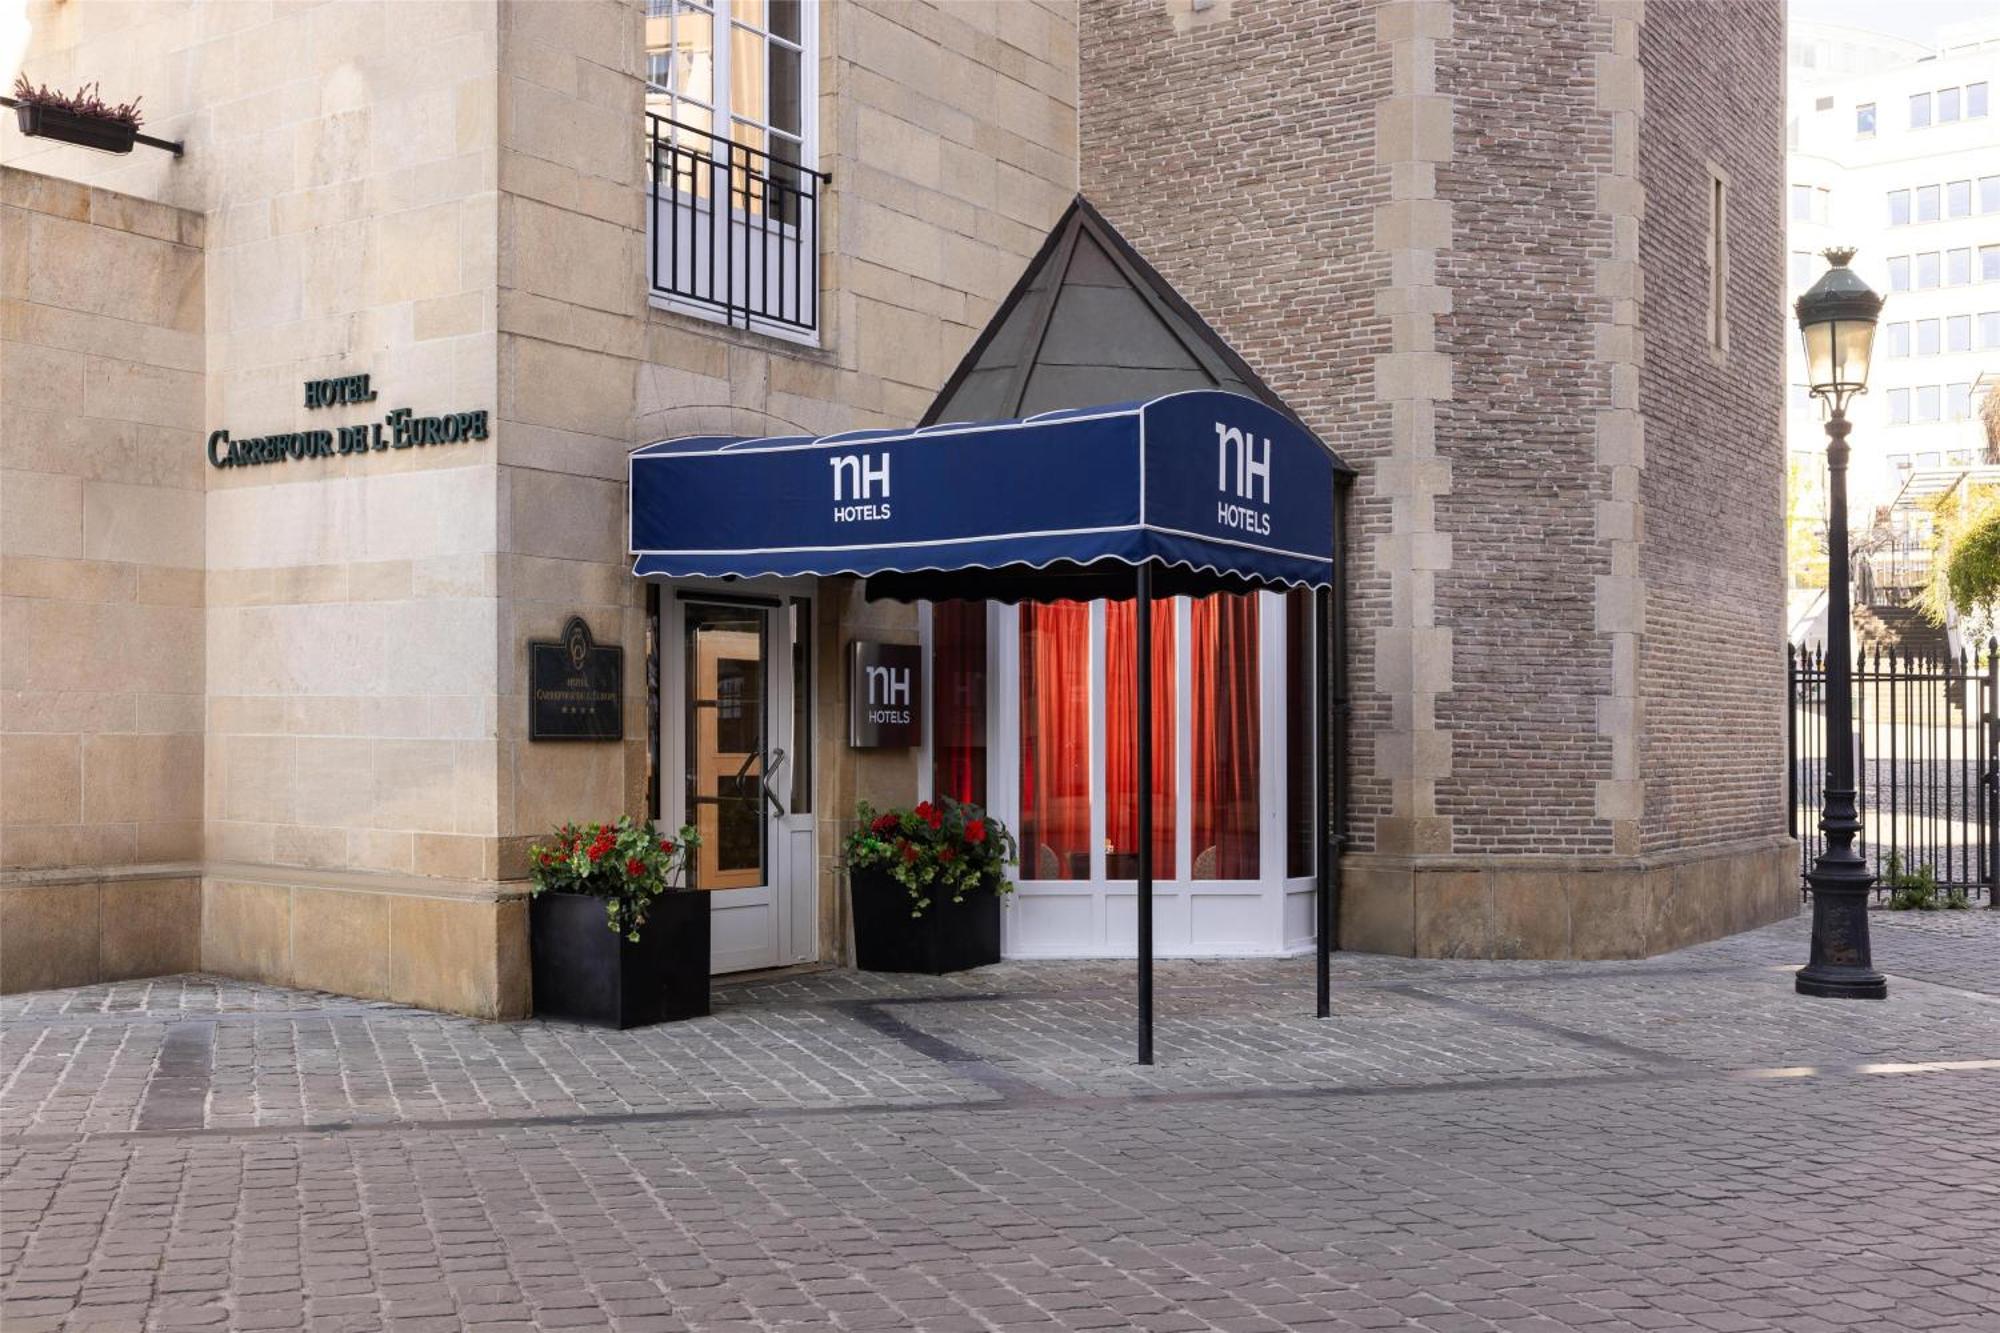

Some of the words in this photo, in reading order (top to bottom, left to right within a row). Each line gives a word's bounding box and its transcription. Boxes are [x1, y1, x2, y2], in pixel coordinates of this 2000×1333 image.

[304, 374, 377, 409] HOTEL
[208, 430, 335, 468] CARREFOUR
[337, 425, 368, 454] DE
[834, 504, 891, 522] HOTELS
[1218, 501, 1270, 535] HOTELS
[868, 710, 911, 724] HOTELS
